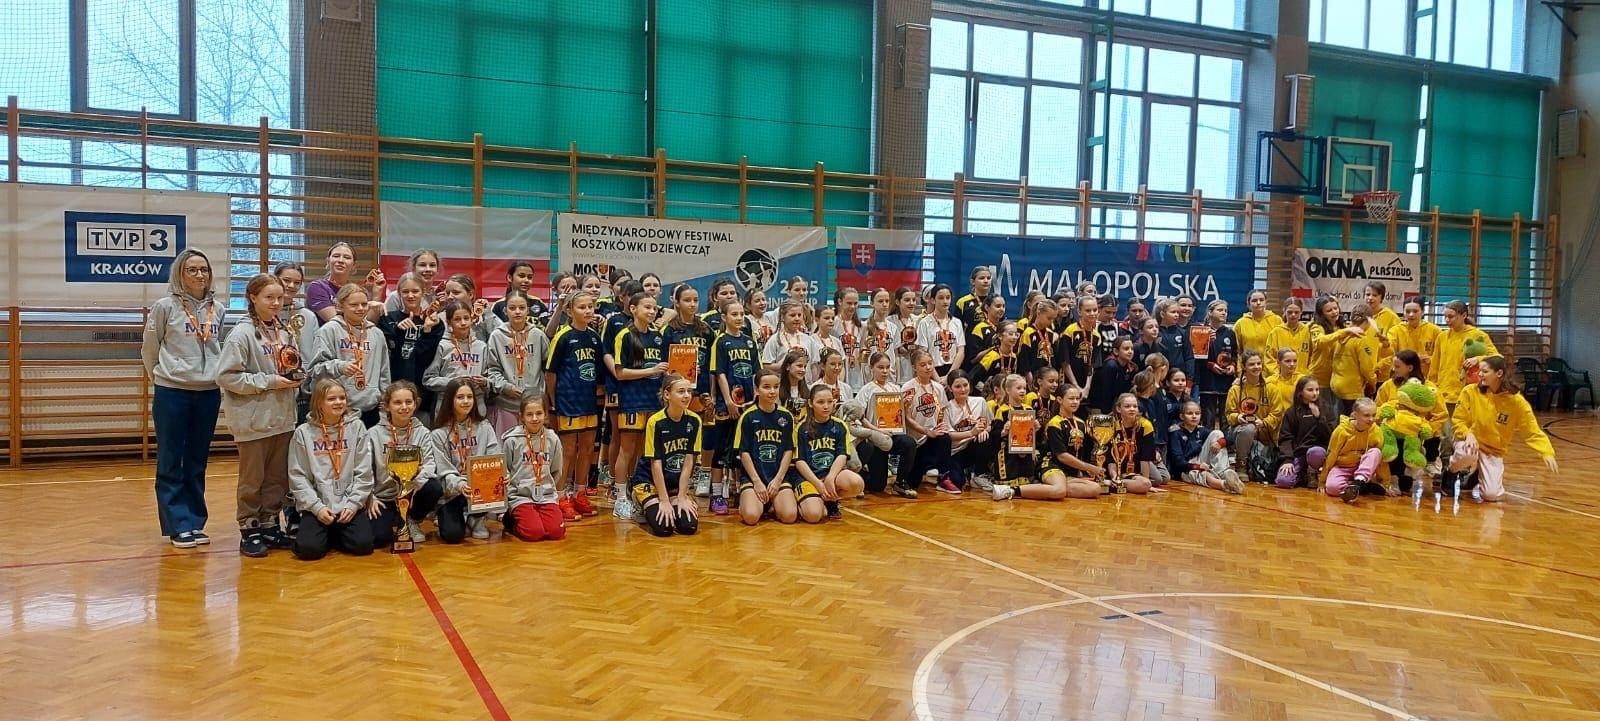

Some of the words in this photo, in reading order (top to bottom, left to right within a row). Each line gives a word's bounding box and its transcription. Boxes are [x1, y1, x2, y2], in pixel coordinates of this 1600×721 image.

[89, 230, 142, 249] TVP
[149, 229, 169, 251] 3
[572, 223, 682, 240] MIĘDZYNARODOWY
[684, 231, 734, 242] FESTIWAL
[571, 238, 647, 252] KOSZYKÓWKI
[650, 243, 711, 257] DZIEWCZĄT
[90, 260, 163, 275] KRAKÓW
[1306, 256, 1367, 279] OKNA
[1028, 269, 1220, 301] MAŁOPOLSKA
[755, 429, 783, 443] YAKE
[808, 436, 836, 451] YAKE
